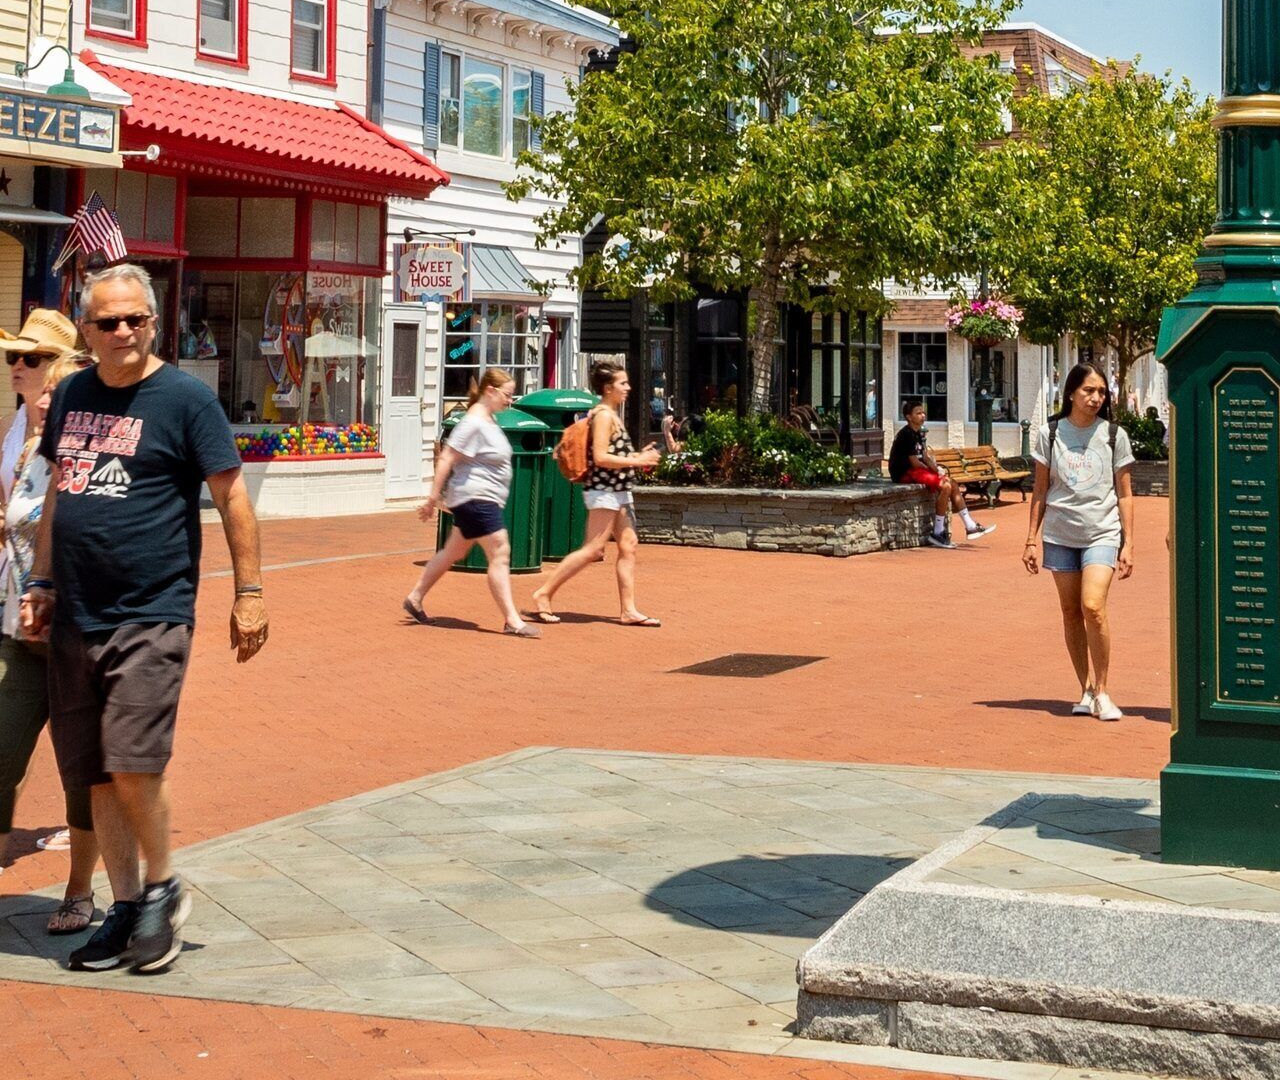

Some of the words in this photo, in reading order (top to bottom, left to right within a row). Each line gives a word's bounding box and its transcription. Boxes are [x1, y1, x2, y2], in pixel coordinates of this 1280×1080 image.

[408, 259, 453, 273] SWEET
[411, 274, 452, 287] HOUSE
[329, 319, 353, 338] SWEE
[63, 411, 143, 441] SARATOGA
